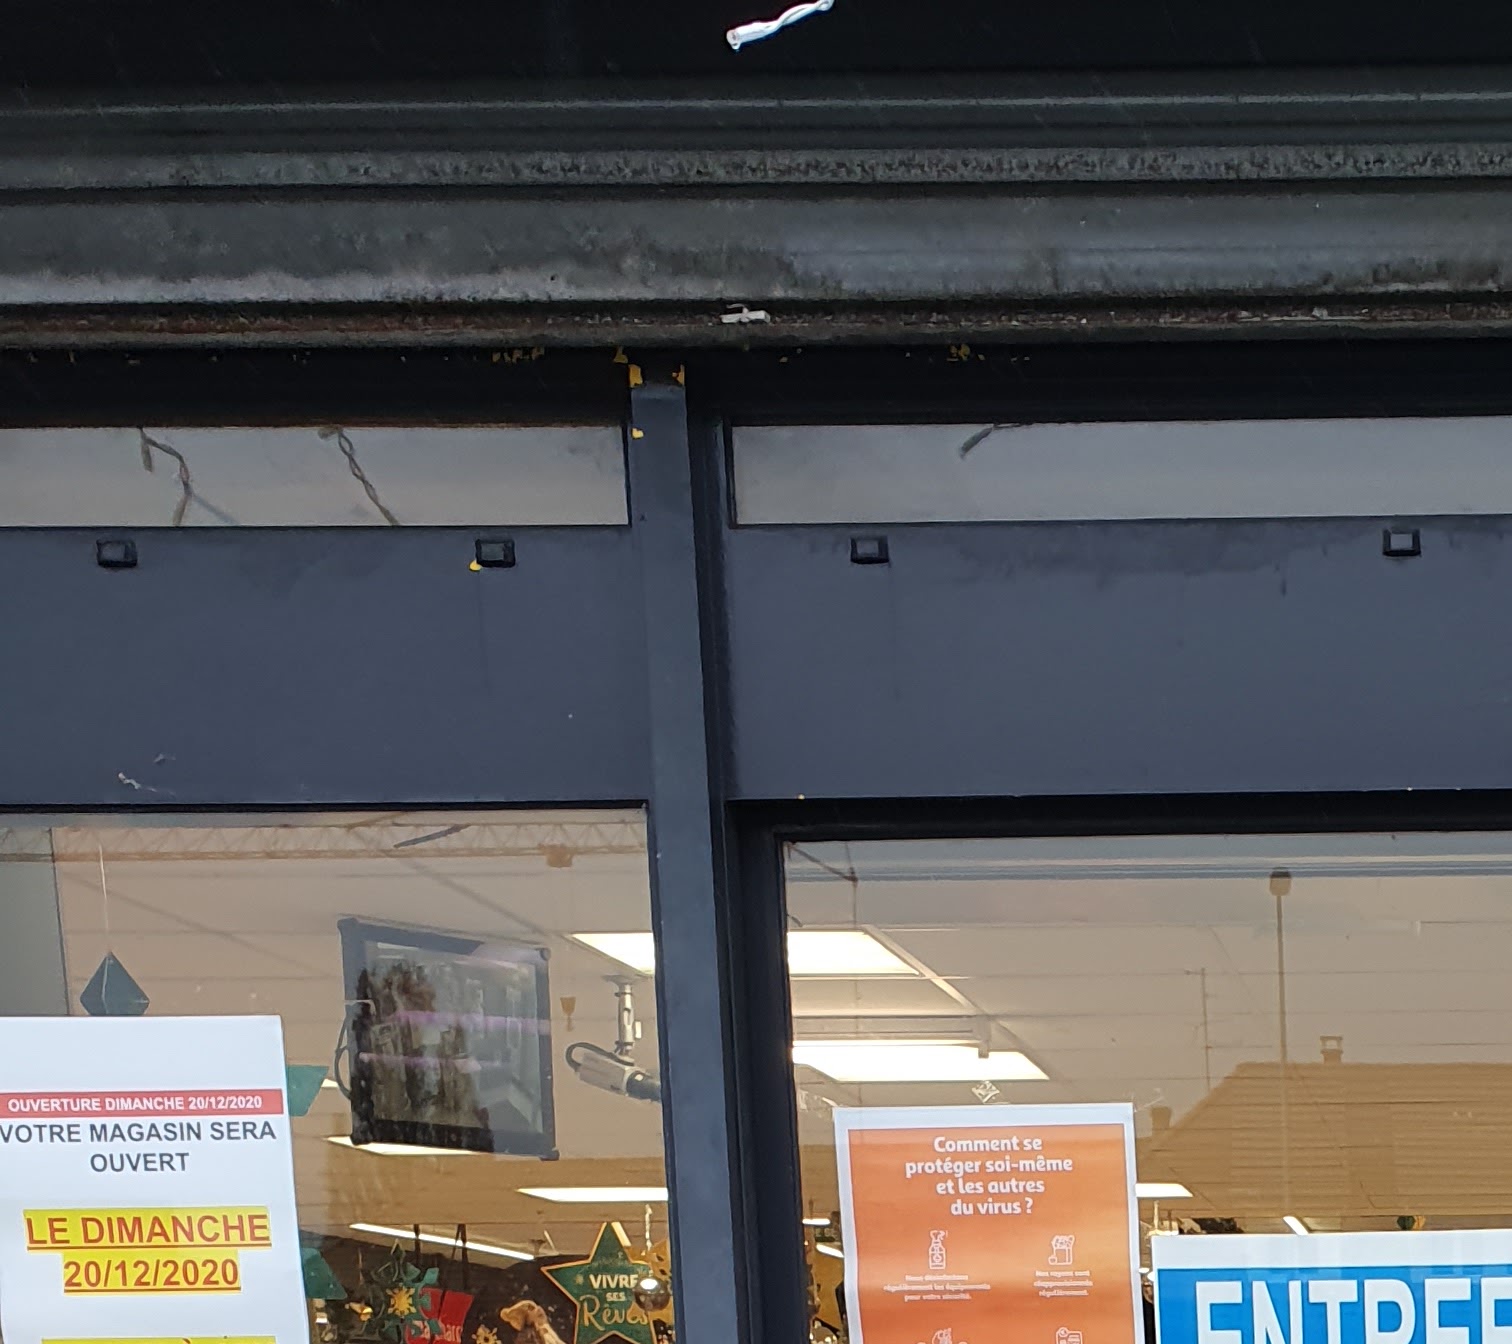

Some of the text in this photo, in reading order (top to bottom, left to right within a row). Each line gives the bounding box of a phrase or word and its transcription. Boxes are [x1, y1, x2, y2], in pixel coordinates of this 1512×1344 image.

[8, 1095, 262, 1113] OUVERTURE DIMANCHE 20/12/2020
[0, 1121, 276, 1143] VOTRE MAGASIN SERA
[934, 1136, 1042, 1153] Comment se
[90, 1152, 189, 1172] OUVERT
[905, 1155, 1073, 1178] protéger soi-même
[936, 1177, 1045, 1194] et les autres
[951, 1197, 1021, 1215] du virus
[26, 1214, 270, 1245] LE DIMANCHE
[64, 1258, 239, 1288] 20/12/2020
[606, 1292, 625, 1302] SES
